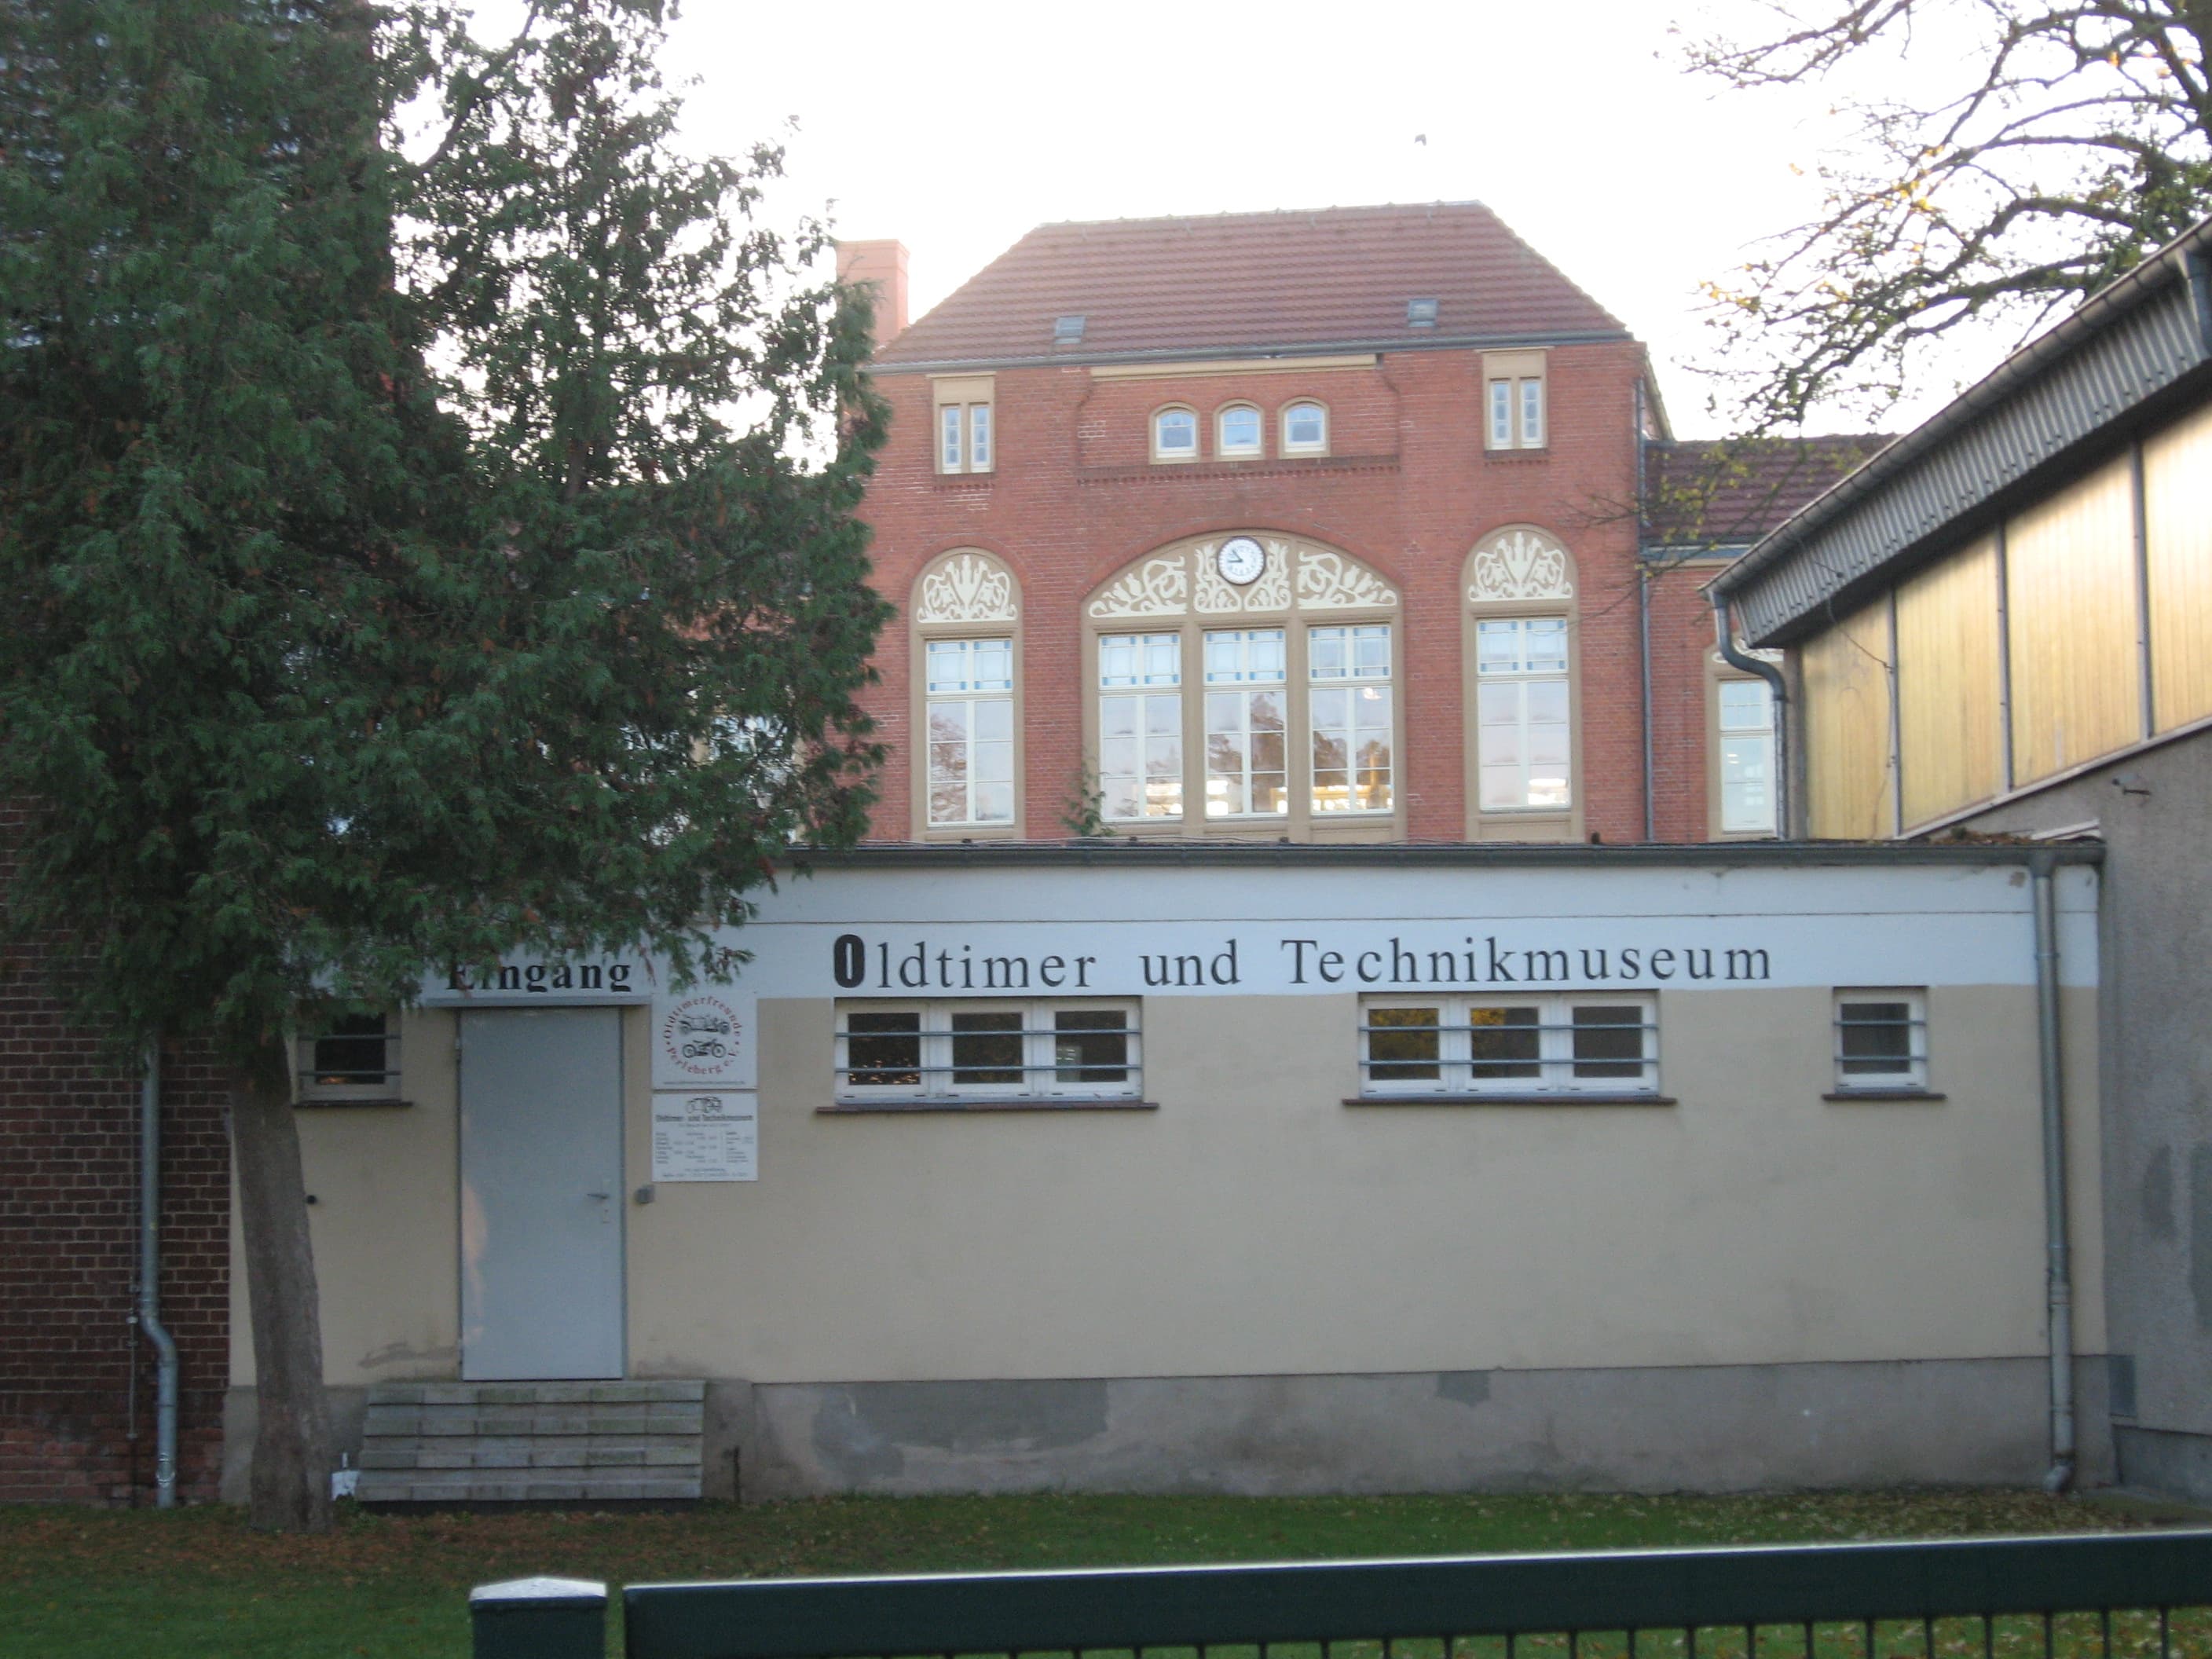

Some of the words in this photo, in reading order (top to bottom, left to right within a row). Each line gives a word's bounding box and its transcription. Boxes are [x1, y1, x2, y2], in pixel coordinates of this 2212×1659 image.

[833, 933, 1097, 989] Oldtimer
[1138, 939, 1242, 987] und
[1280, 936, 1771, 984] Technikmuseum
